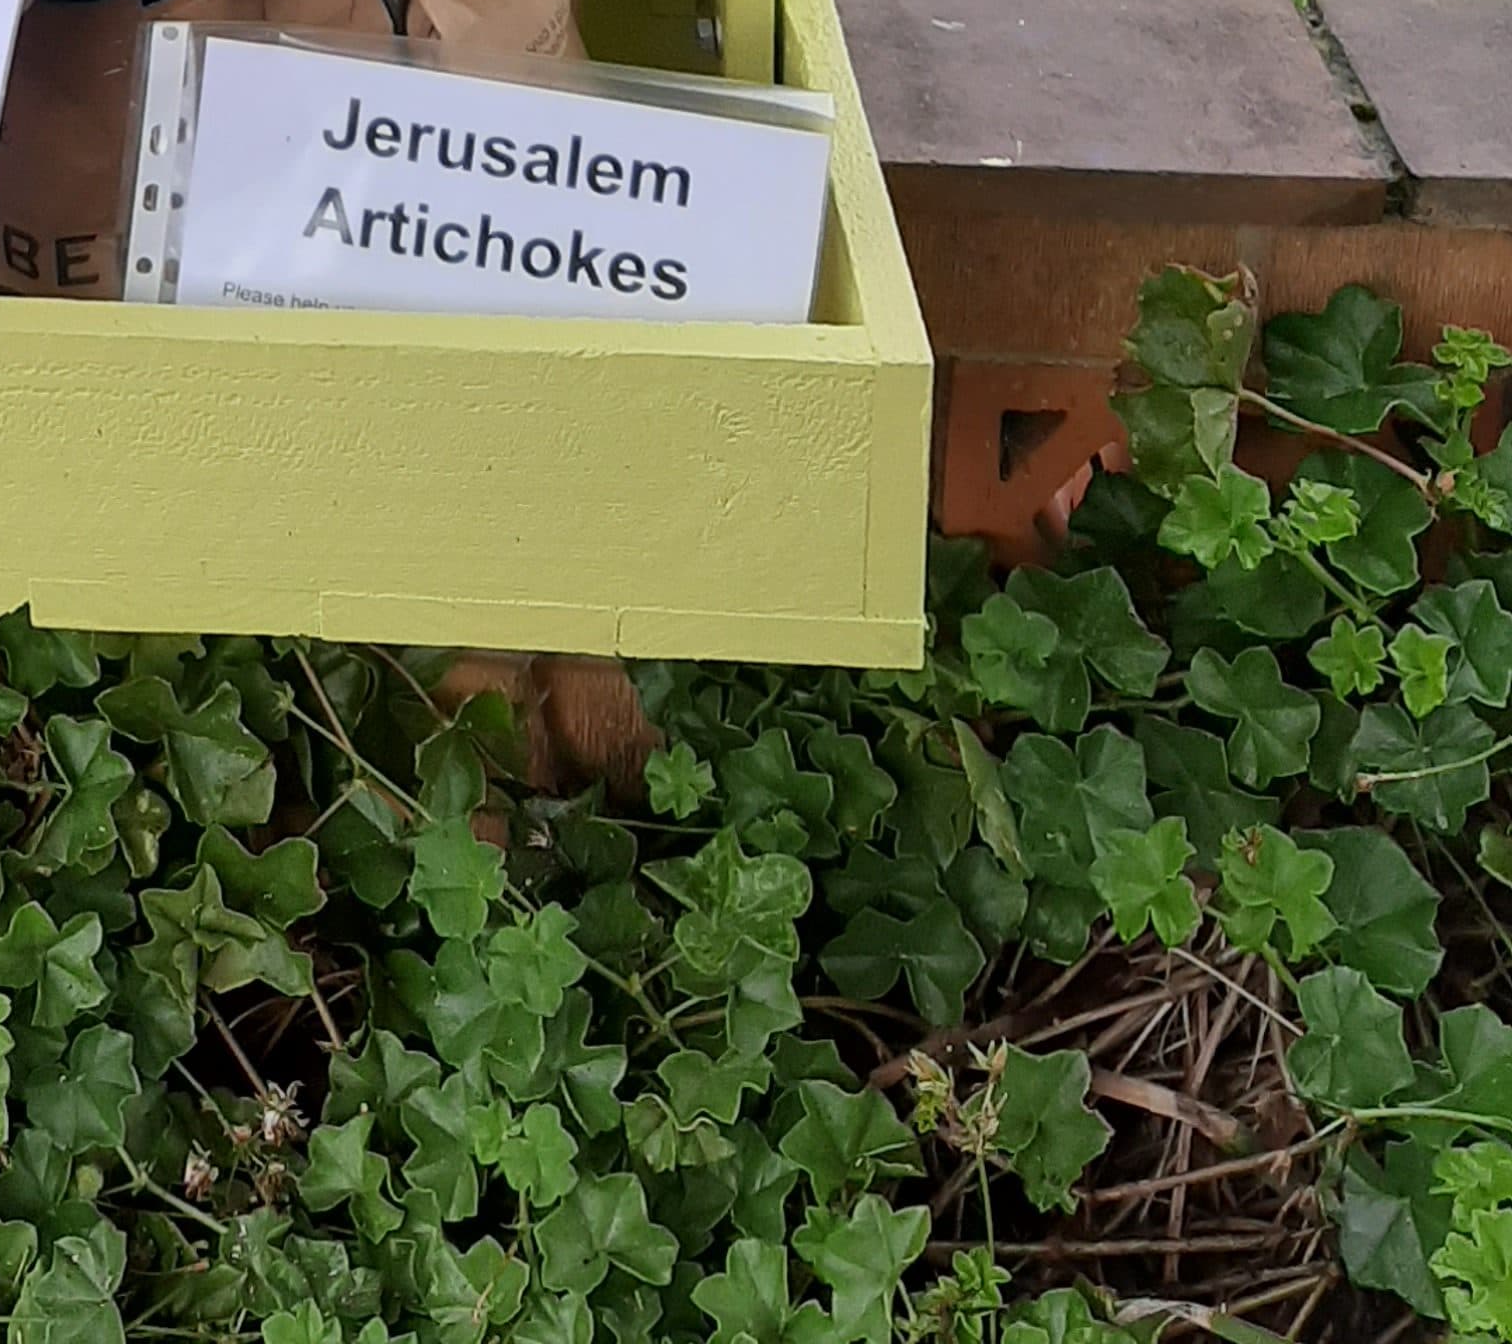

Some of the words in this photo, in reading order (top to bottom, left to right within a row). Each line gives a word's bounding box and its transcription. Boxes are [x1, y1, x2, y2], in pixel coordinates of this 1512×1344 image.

[322, 97, 692, 208] Jerusalem
[222, 280, 285, 308] Please
[303, 186, 690, 301] Artichokes
